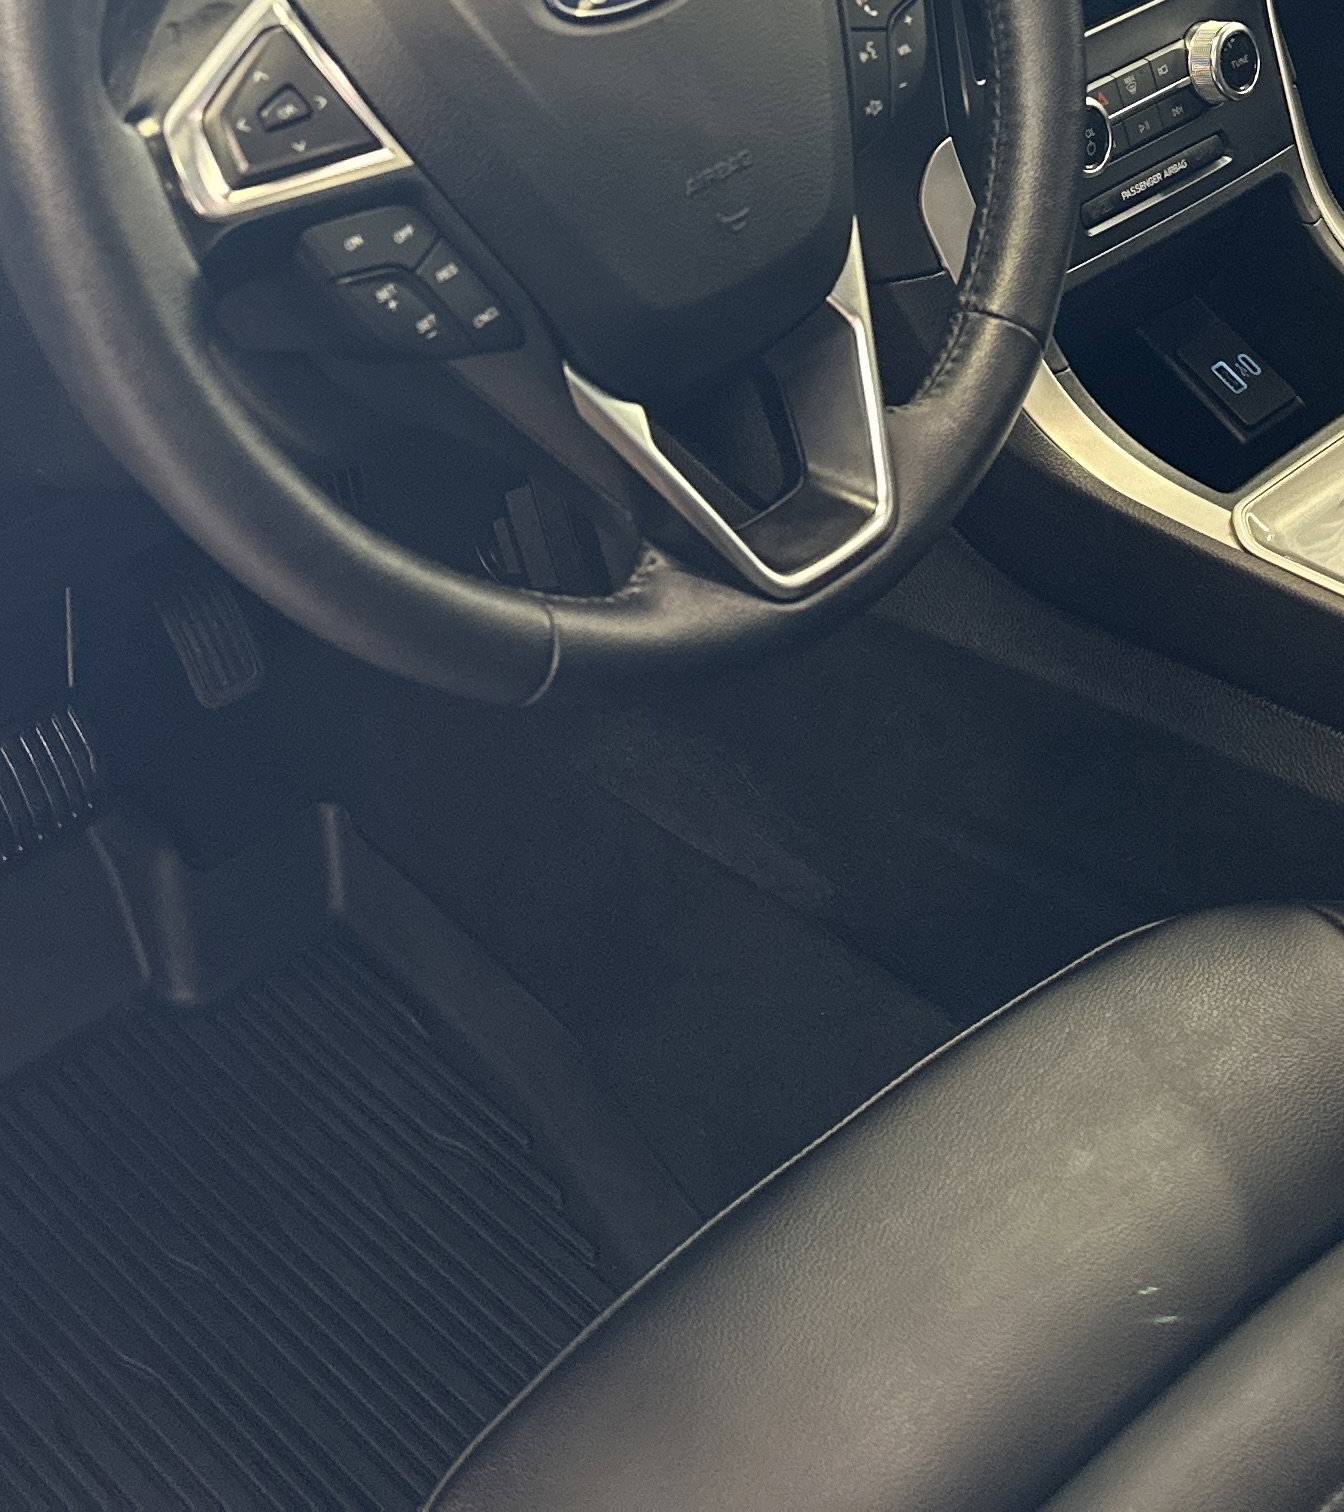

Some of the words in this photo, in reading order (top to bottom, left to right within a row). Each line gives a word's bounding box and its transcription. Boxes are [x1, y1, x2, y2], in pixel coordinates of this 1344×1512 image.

[1231, 54, 1249, 69] TUNE
[1120, 172, 1163, 201] PASSENGER
[1163, 158, 1188, 179] AIRBAG
